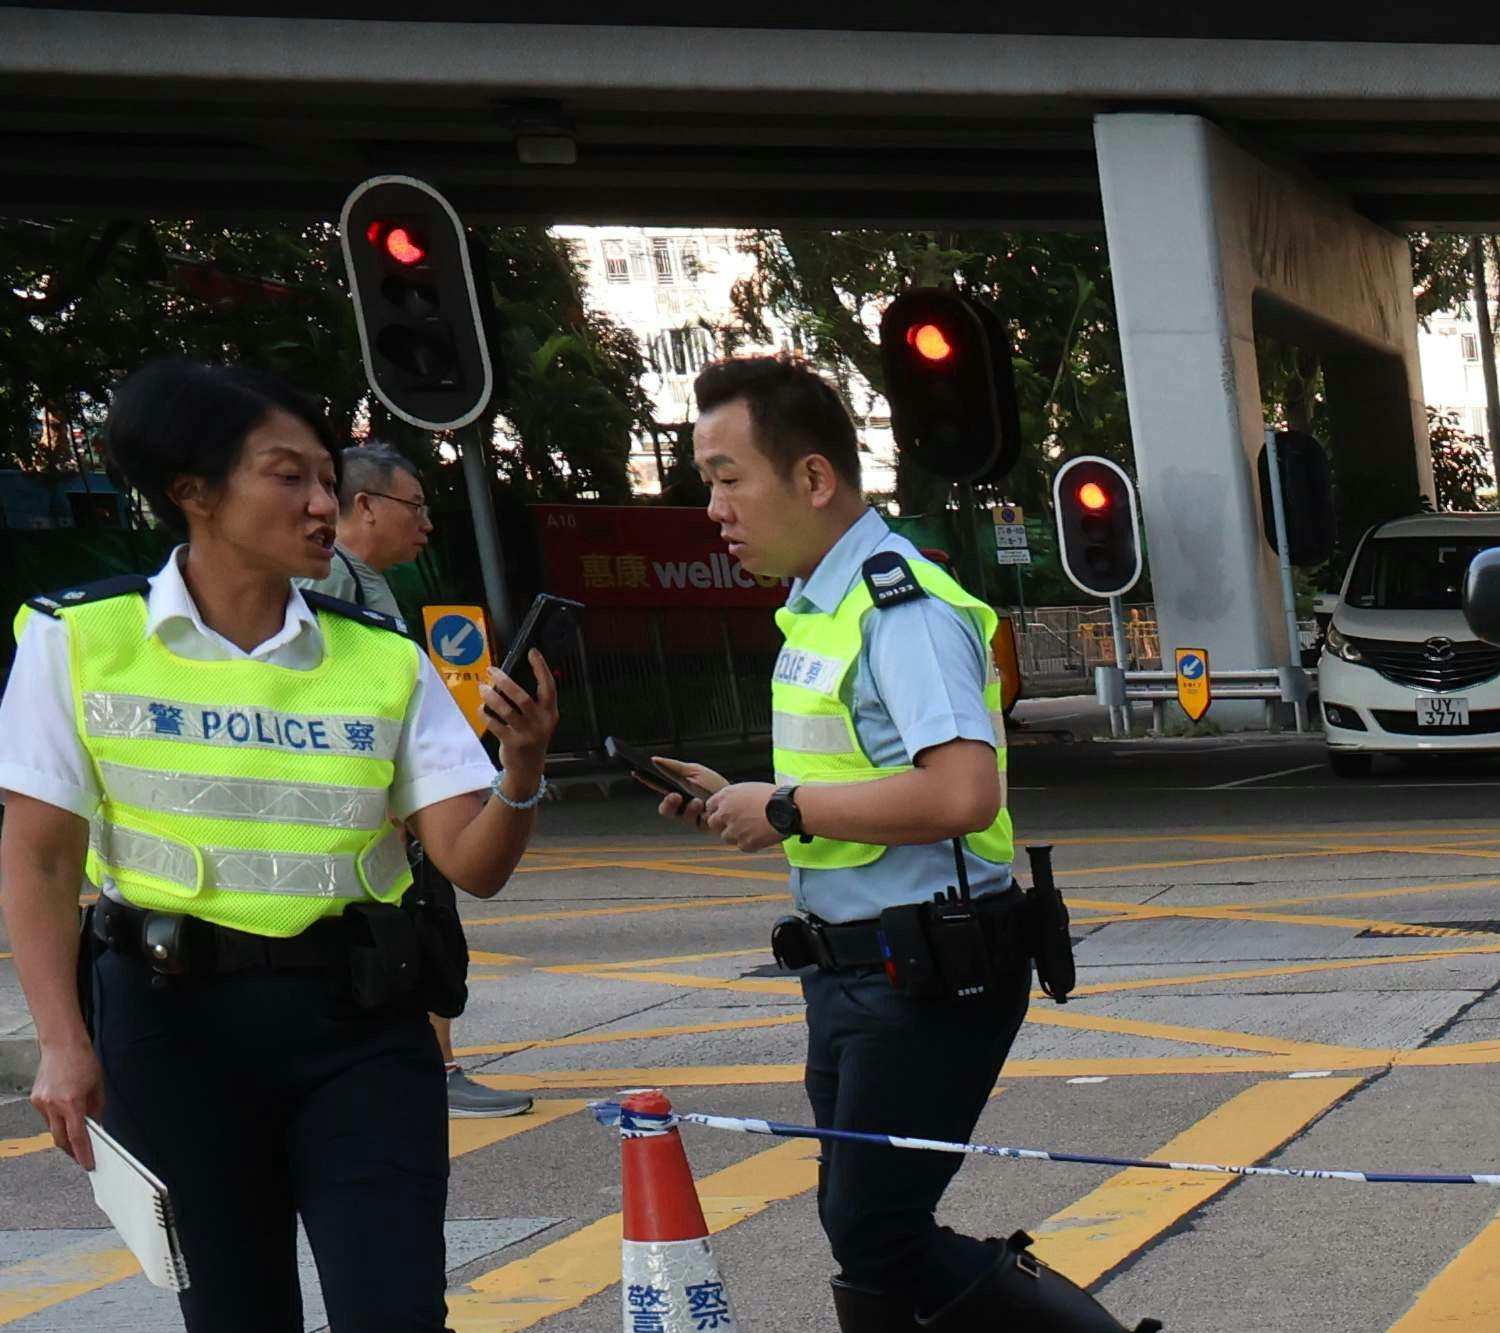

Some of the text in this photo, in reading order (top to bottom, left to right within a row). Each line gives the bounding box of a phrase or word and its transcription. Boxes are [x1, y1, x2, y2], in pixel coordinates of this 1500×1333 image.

[579, 552, 650, 589] 惠康
[1424, 711, 1462, 726] 3771
[1430, 698, 1452, 713] UY
[149, 702, 375, 752] 警 POLICE 察
[628, 1279, 731, 1333] 警察
